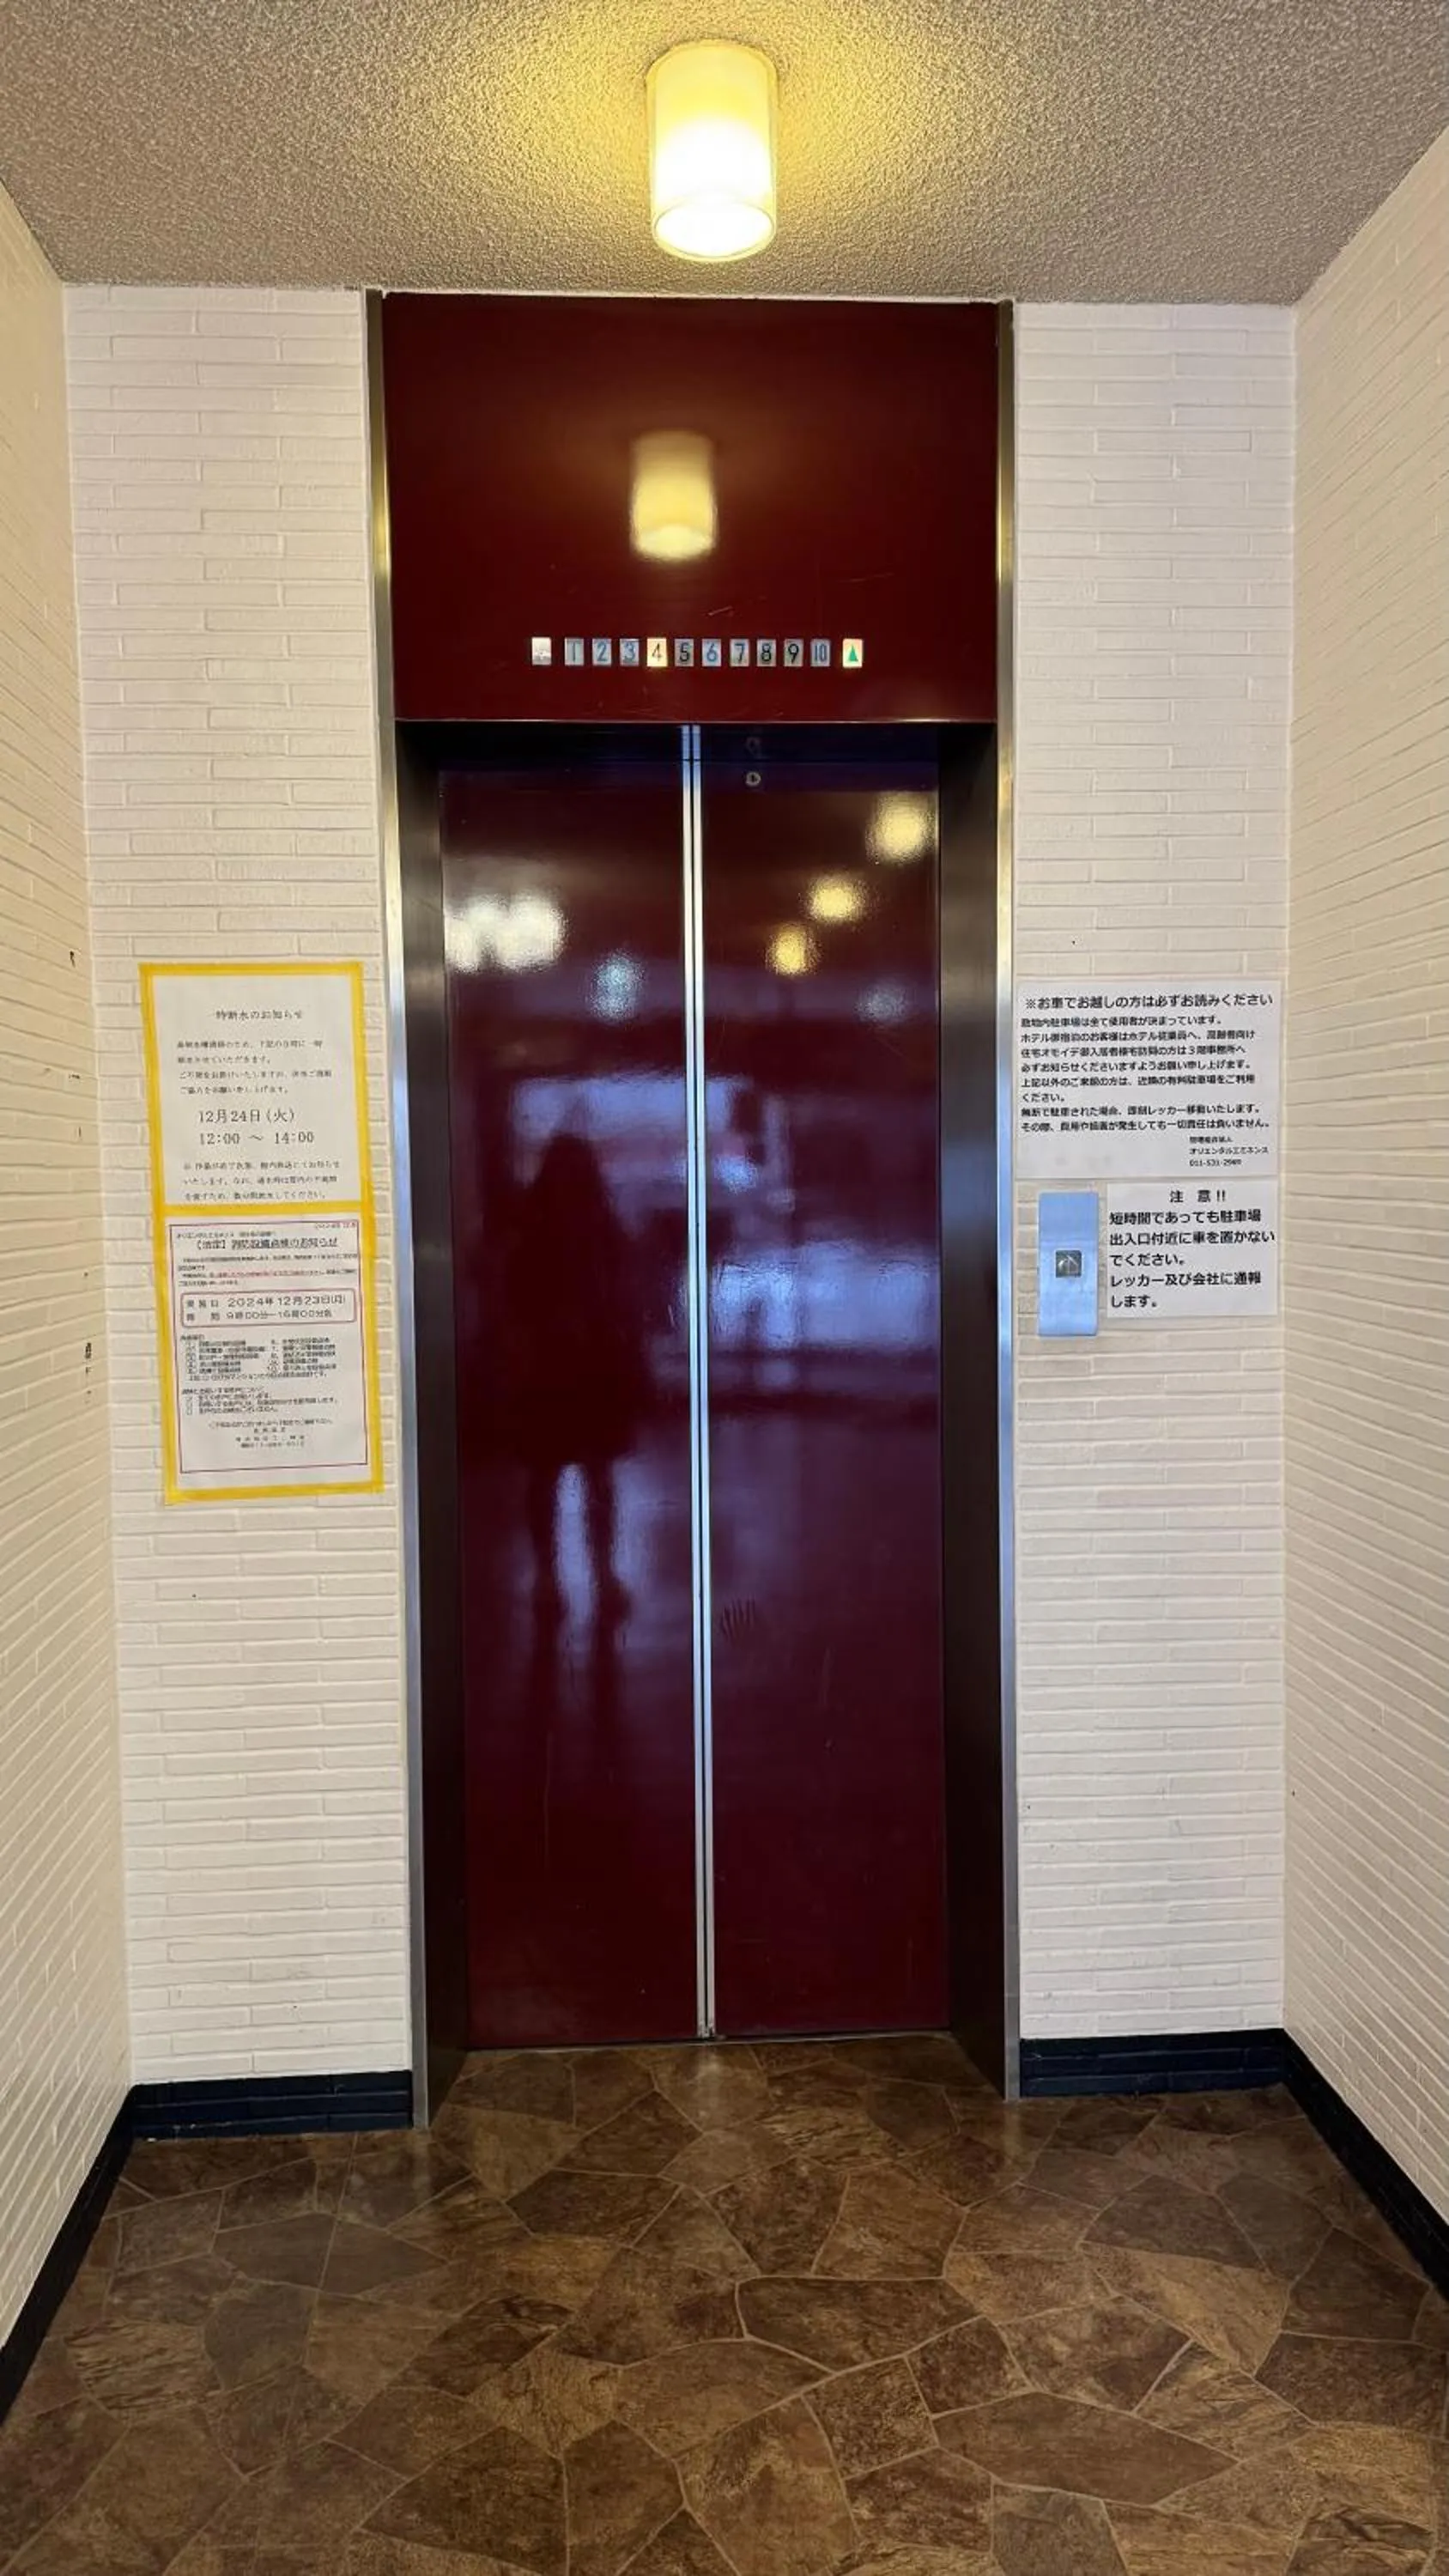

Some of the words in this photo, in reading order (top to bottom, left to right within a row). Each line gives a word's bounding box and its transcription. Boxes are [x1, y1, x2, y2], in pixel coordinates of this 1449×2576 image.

[597, 642, 607, 661] 2
[624, 642, 635, 661] 3
[652, 643, 662, 661] 4
[679, 642, 689, 661] 5
[706, 643, 717, 662] 6
[735, 643, 745, 663] 7
[761, 643, 772, 662] 8
[788, 643, 799, 663] 9
[815, 644, 827, 661] 10
[1026, 993, 1273, 1010] ※お車でお越しの方は必ずお読みください
[1022, 1093, 1064, 1103] ください。
[199, 1133, 240, 1145] 12:00
[274, 1131, 314, 1145] 14:00
[1109, 1209, 1262, 1225] 短時間であっても駐車場
[1109, 1230, 1275, 1246] 出入口付近に車を置かない
[1110, 1253, 1186, 1267] でください。
[1110, 1271, 1262, 1288] レッカー及び会社に通報
[1110, 1295, 1159, 1308] します。
